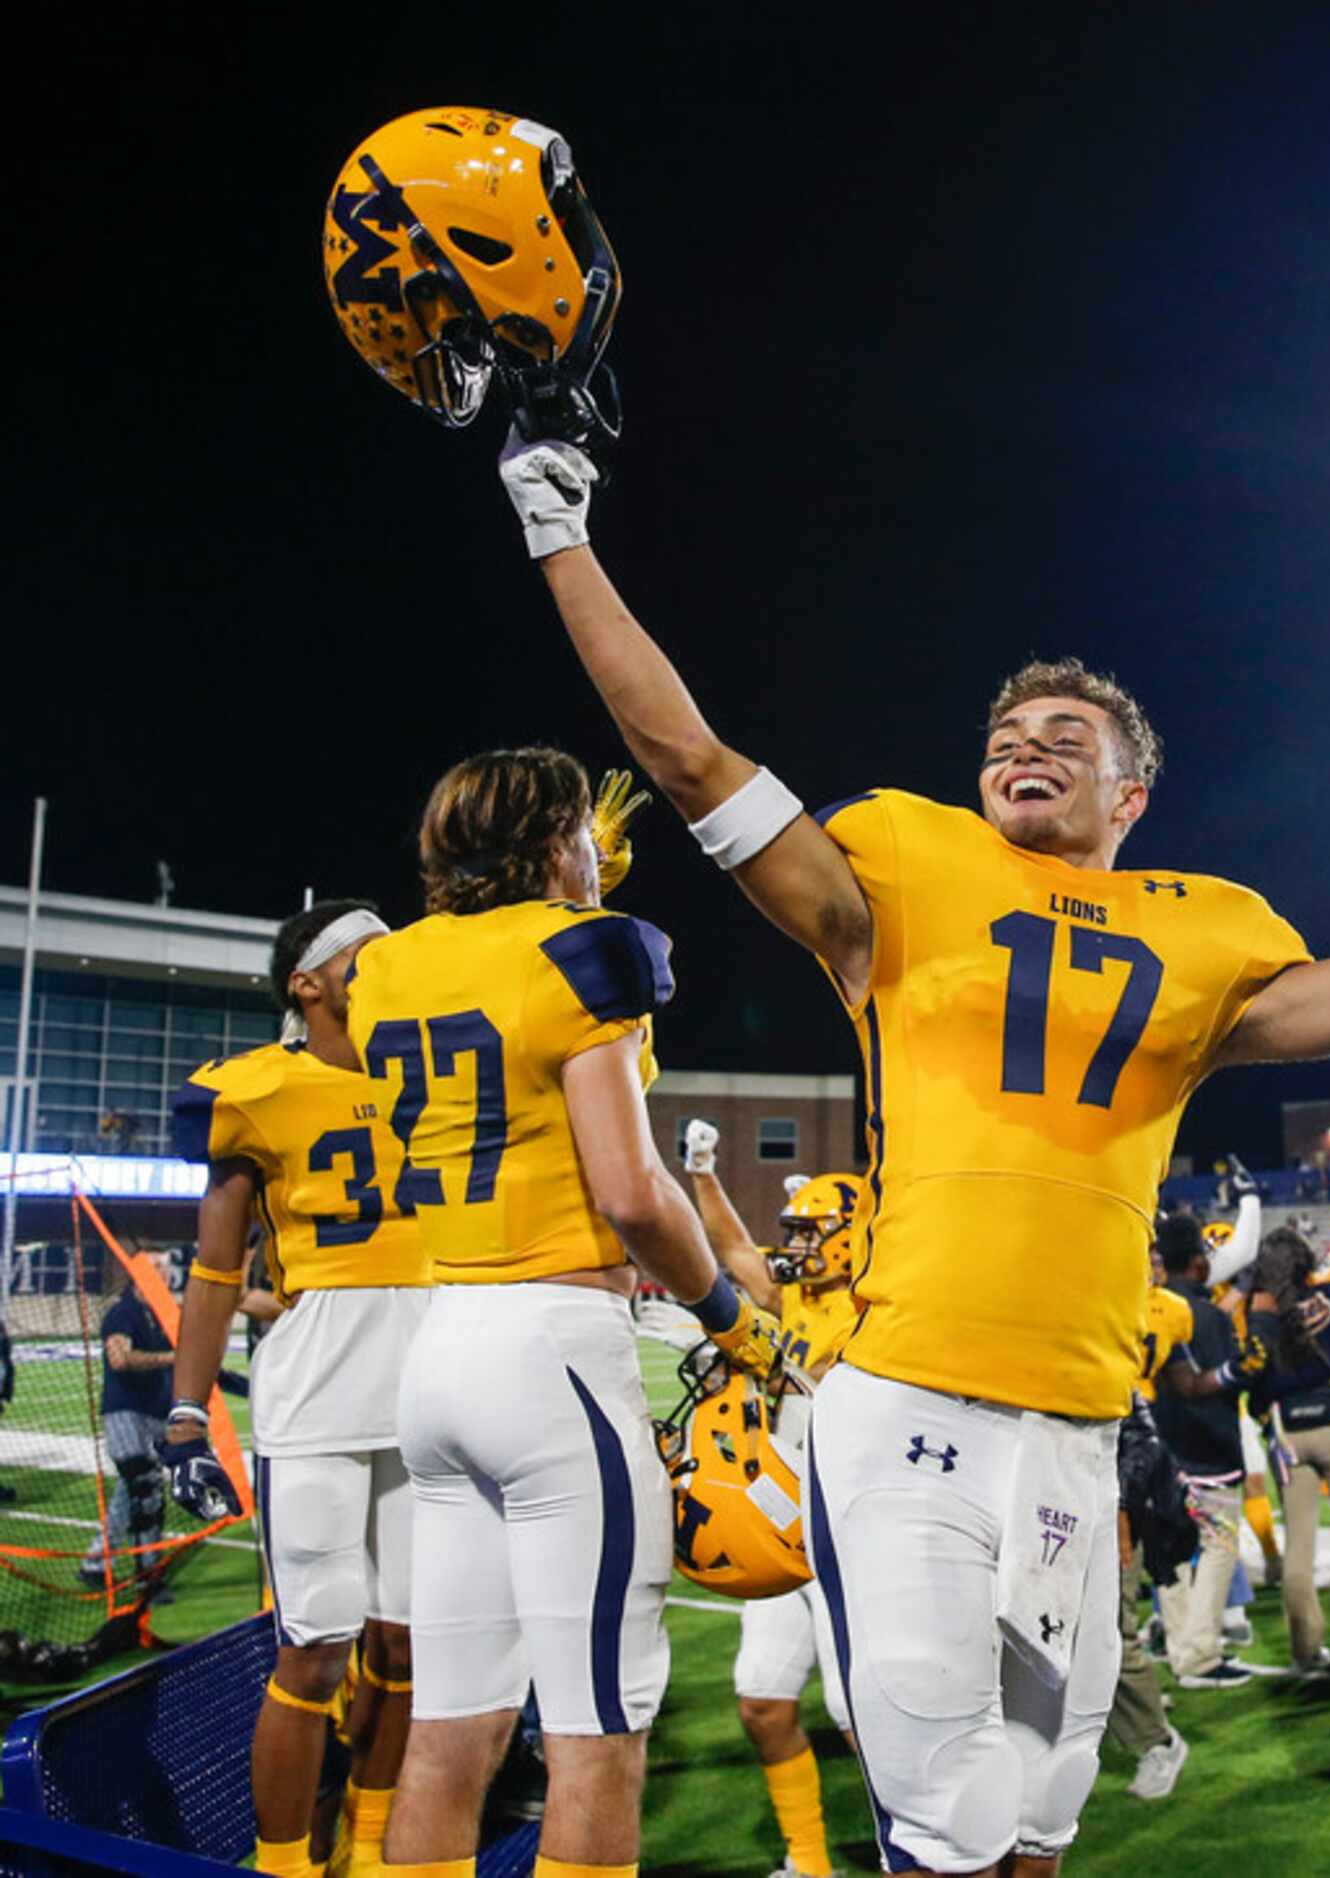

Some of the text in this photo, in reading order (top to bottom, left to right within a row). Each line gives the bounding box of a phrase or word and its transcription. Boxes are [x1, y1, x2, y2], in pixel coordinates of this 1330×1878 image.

[1048, 893, 1108, 926] LIONS
[989, 909, 1165, 1111] 17
[363, 1008, 508, 1206] 27
[308, 1126, 384, 1248] 3
[1040, 1529, 1068, 1567] 17
